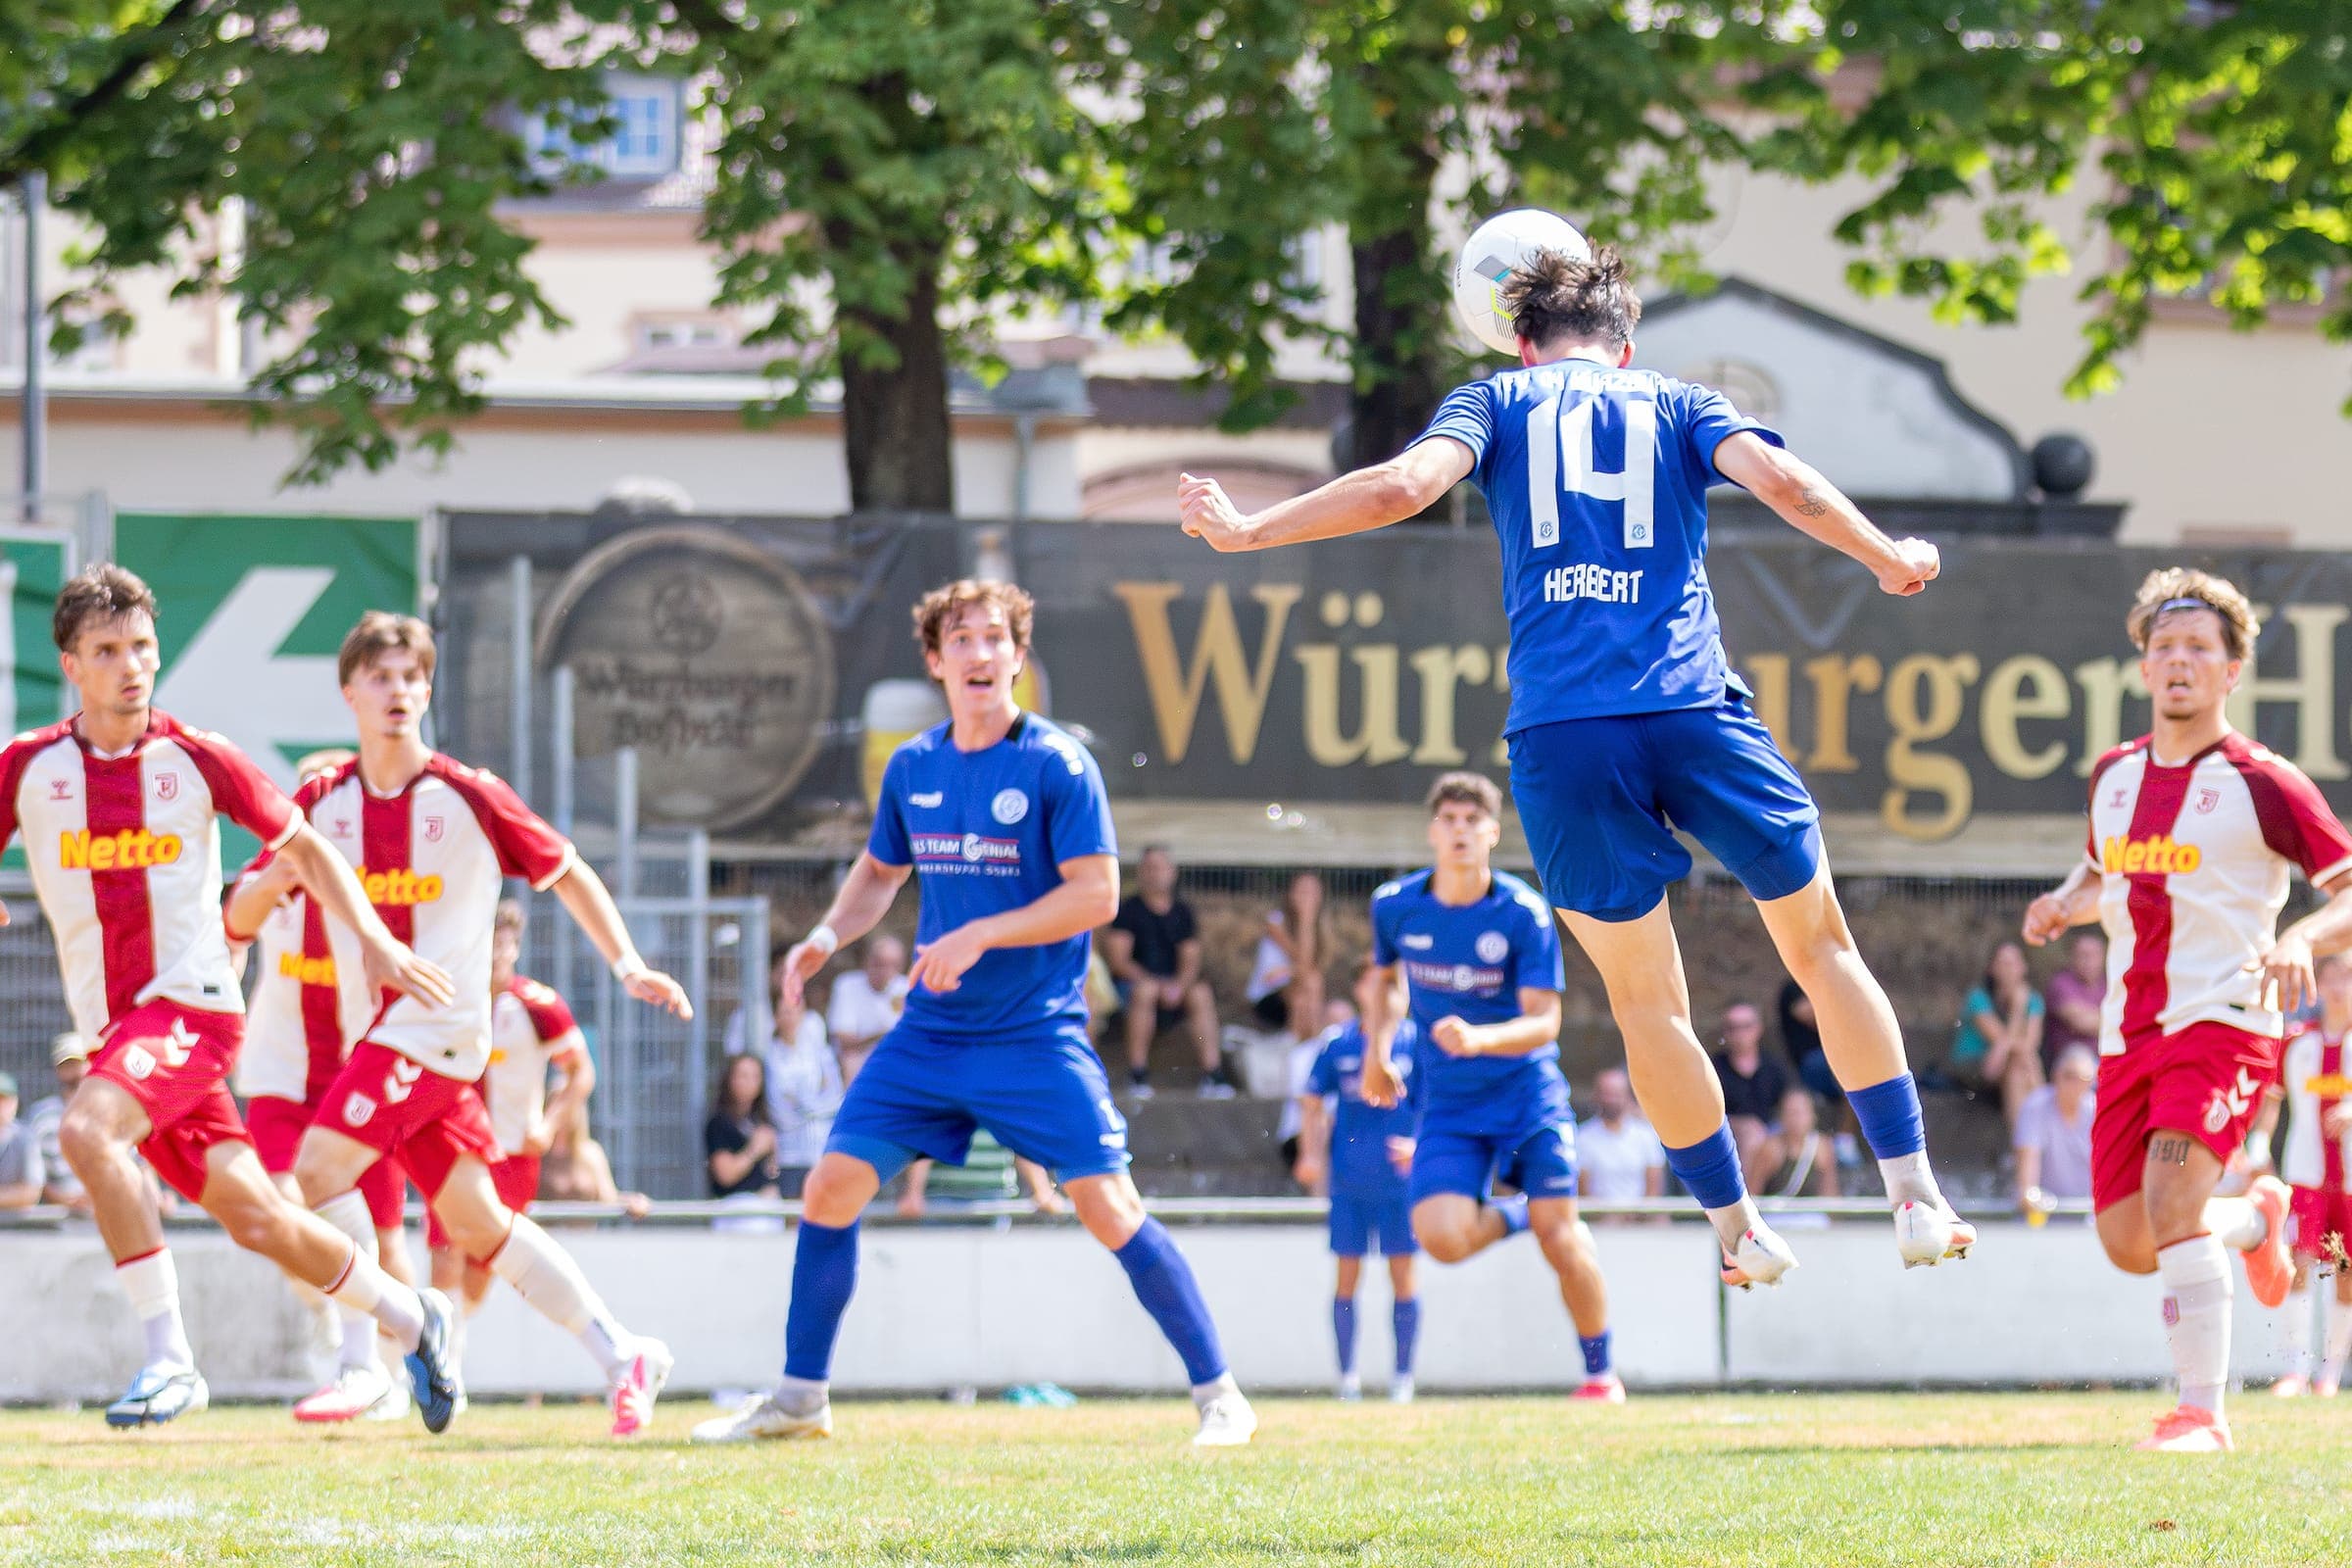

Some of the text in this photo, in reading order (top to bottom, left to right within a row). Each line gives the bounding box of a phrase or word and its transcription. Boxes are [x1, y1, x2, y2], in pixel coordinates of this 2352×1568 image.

[1527, 396, 1657, 550] 14
[1544, 563, 1644, 605] HERBERT
[2223, 603, 2352, 781] H
[60, 827, 183, 870] Netto
[2103, 833, 2202, 875] Netto
[356, 865, 445, 906] etto
[279, 951, 338, 987] Net
